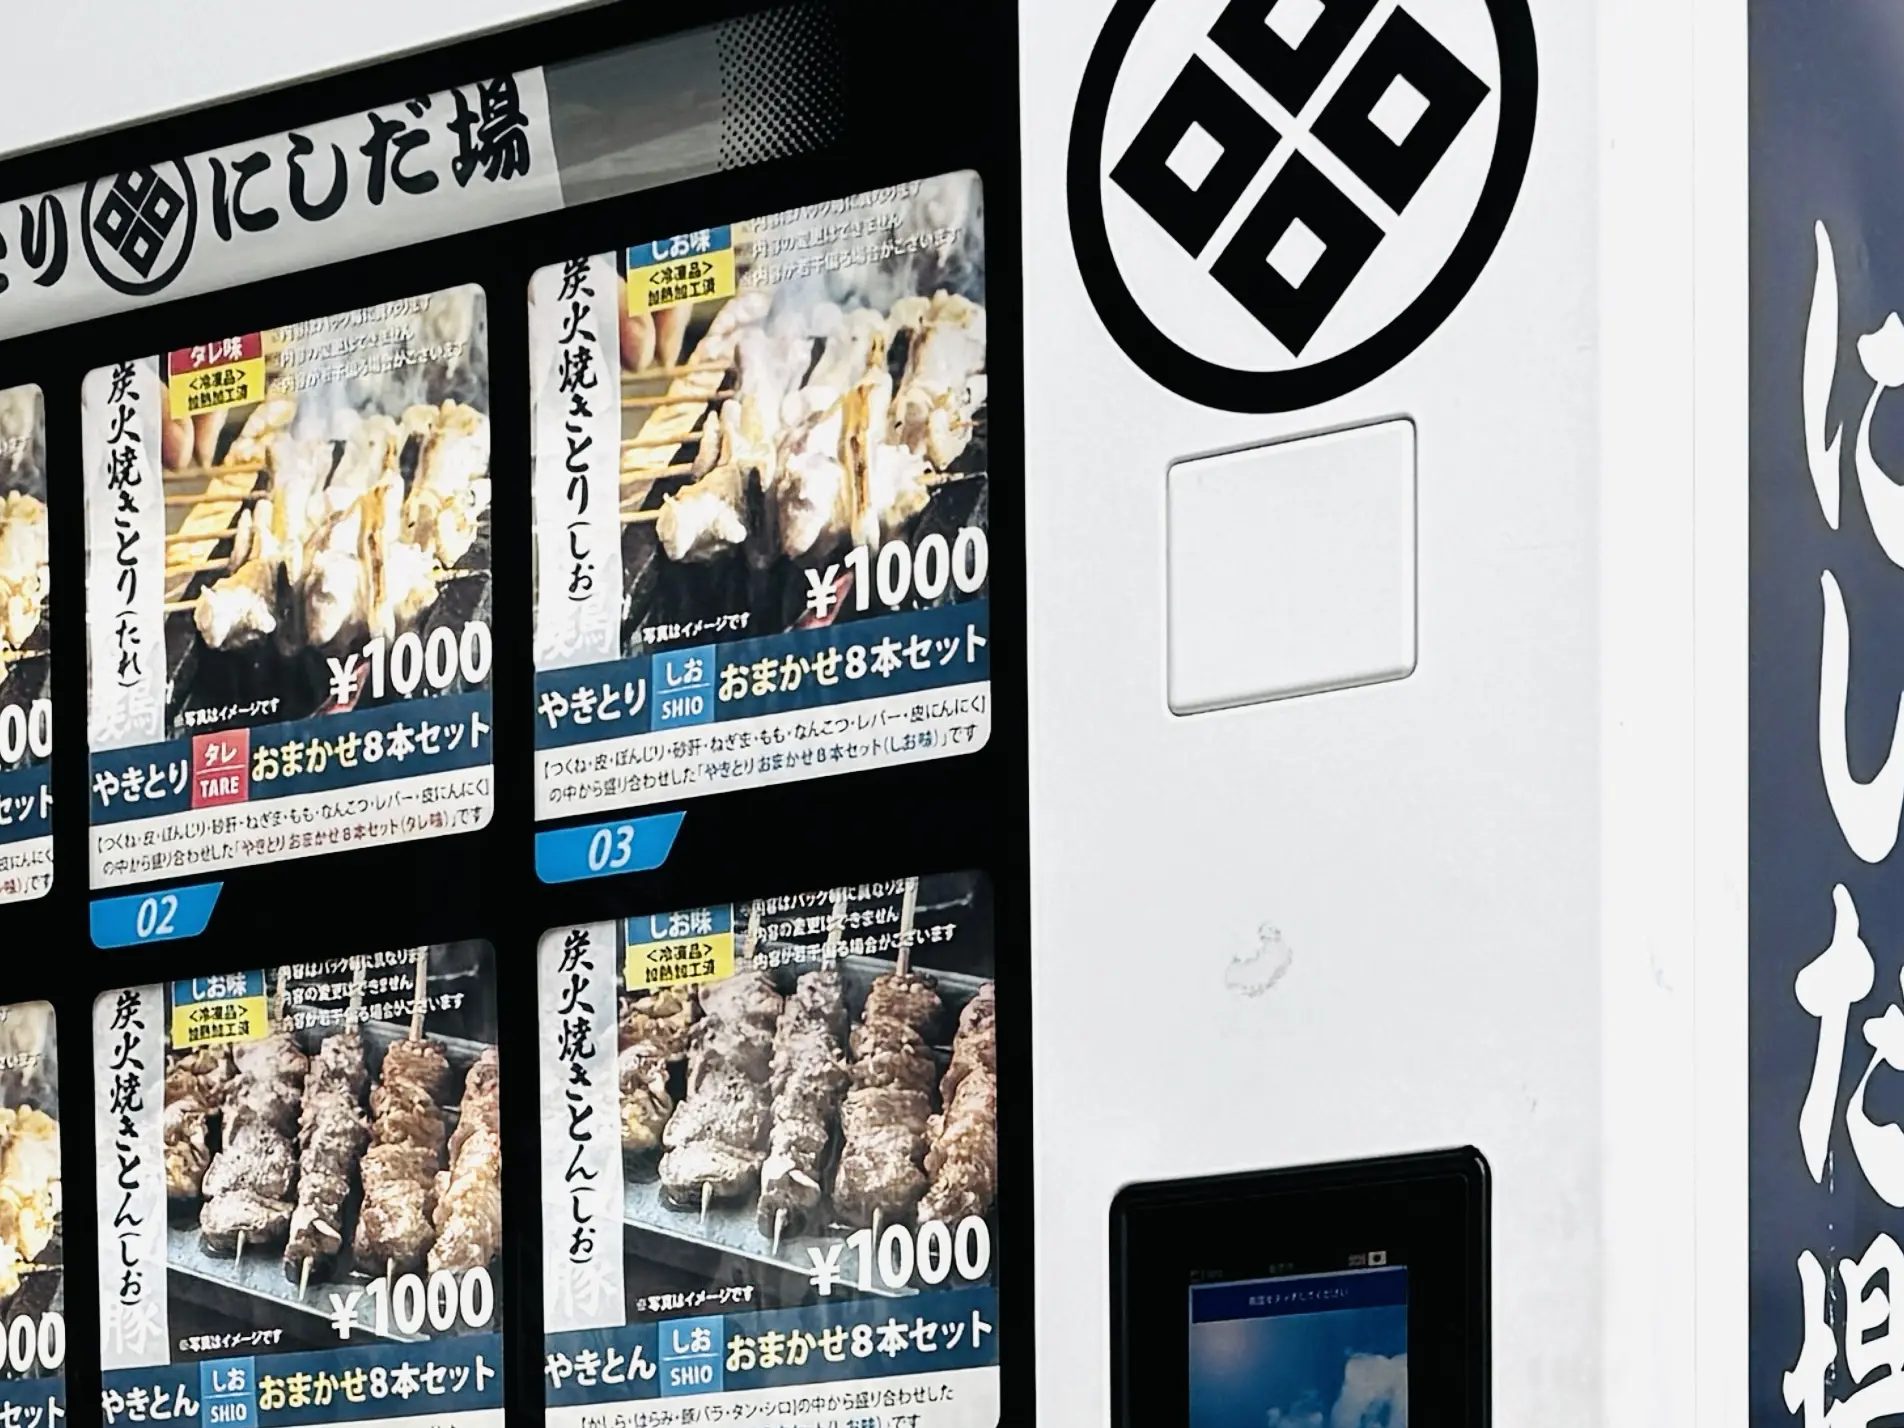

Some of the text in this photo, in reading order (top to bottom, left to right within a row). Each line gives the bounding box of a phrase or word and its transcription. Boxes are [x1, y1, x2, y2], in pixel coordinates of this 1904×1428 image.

[210, 72, 530, 242] にしだ場
[804, 526, 989, 619] ¥1000
[326, 619, 493, 705] ¥1000
[537, 624, 988, 730] やきとり おまかせ8本セット
[665, 658, 703, 687] しお
[660, 694, 704, 720] SHIO
[93, 711, 490, 807] やきとり おまかせ8本セット
[203, 740, 237, 764] タレ
[199, 775, 240, 799] TARE
[588, 826, 634, 872] 03
[136, 896, 178, 938] 02
[649, 909, 712, 938] しお味
[807, 1214, 991, 1297] ¥1000
[329, 1267, 495, 1340] ¥1000
[544, 1310, 993, 1389] やきとん おまかせ8本セット
[671, 1327, 711, 1355] しお
[101, 1355, 495, 1426] やきとん おまかせ8本セット
[212, 1368, 246, 1393] しお
[669, 1364, 713, 1386] SHIO
[210, 1403, 248, 1424] SHIO
